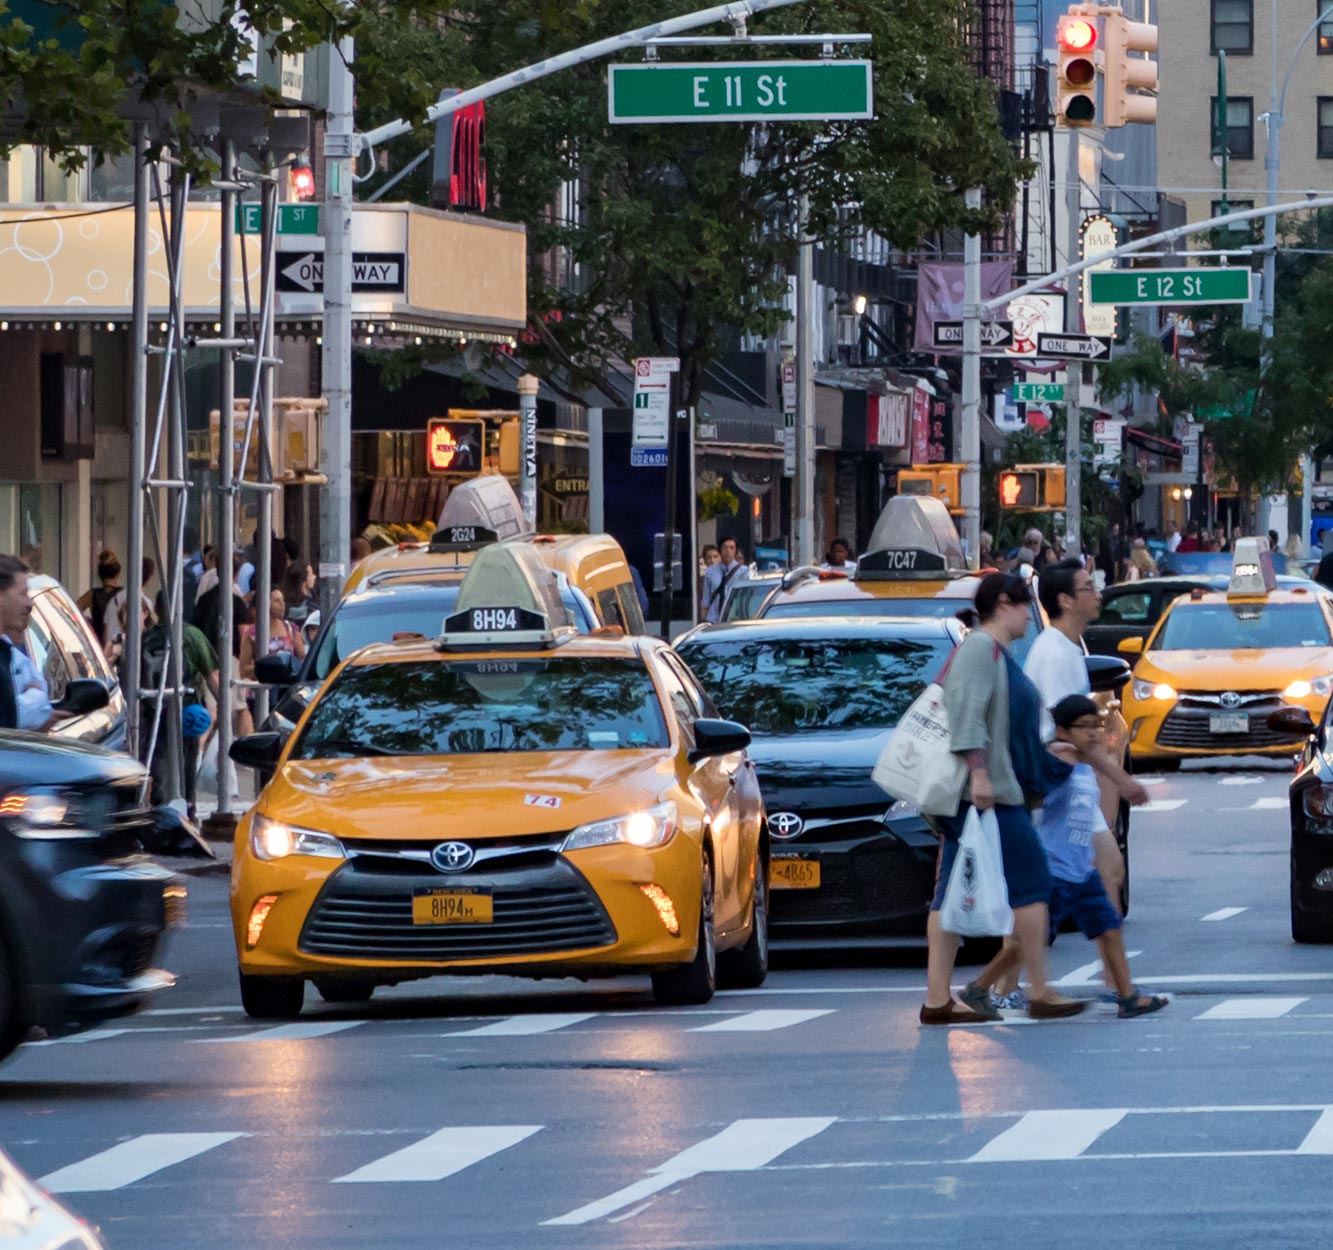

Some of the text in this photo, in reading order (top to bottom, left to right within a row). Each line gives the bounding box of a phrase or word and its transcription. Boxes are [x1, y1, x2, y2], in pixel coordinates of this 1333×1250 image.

[693, 75, 787, 107] E 11 St
[245, 208, 258, 231] E
[293, 208, 306, 221] ST
[1088, 234, 1111, 246] BAR
[299, 264, 391, 281] ON WAY
[1137, 276, 1203, 298] E 12 St
[1047, 340, 1100, 353] ONE WAY
[1018, 385, 1025, 400] E
[1031, 385, 1046, 400] 12
[555, 479, 590, 493] ENTRA
[451, 527, 476, 543] 2G24
[887, 550, 918, 569] 7C47
[473, 608, 518, 631] 8H94
